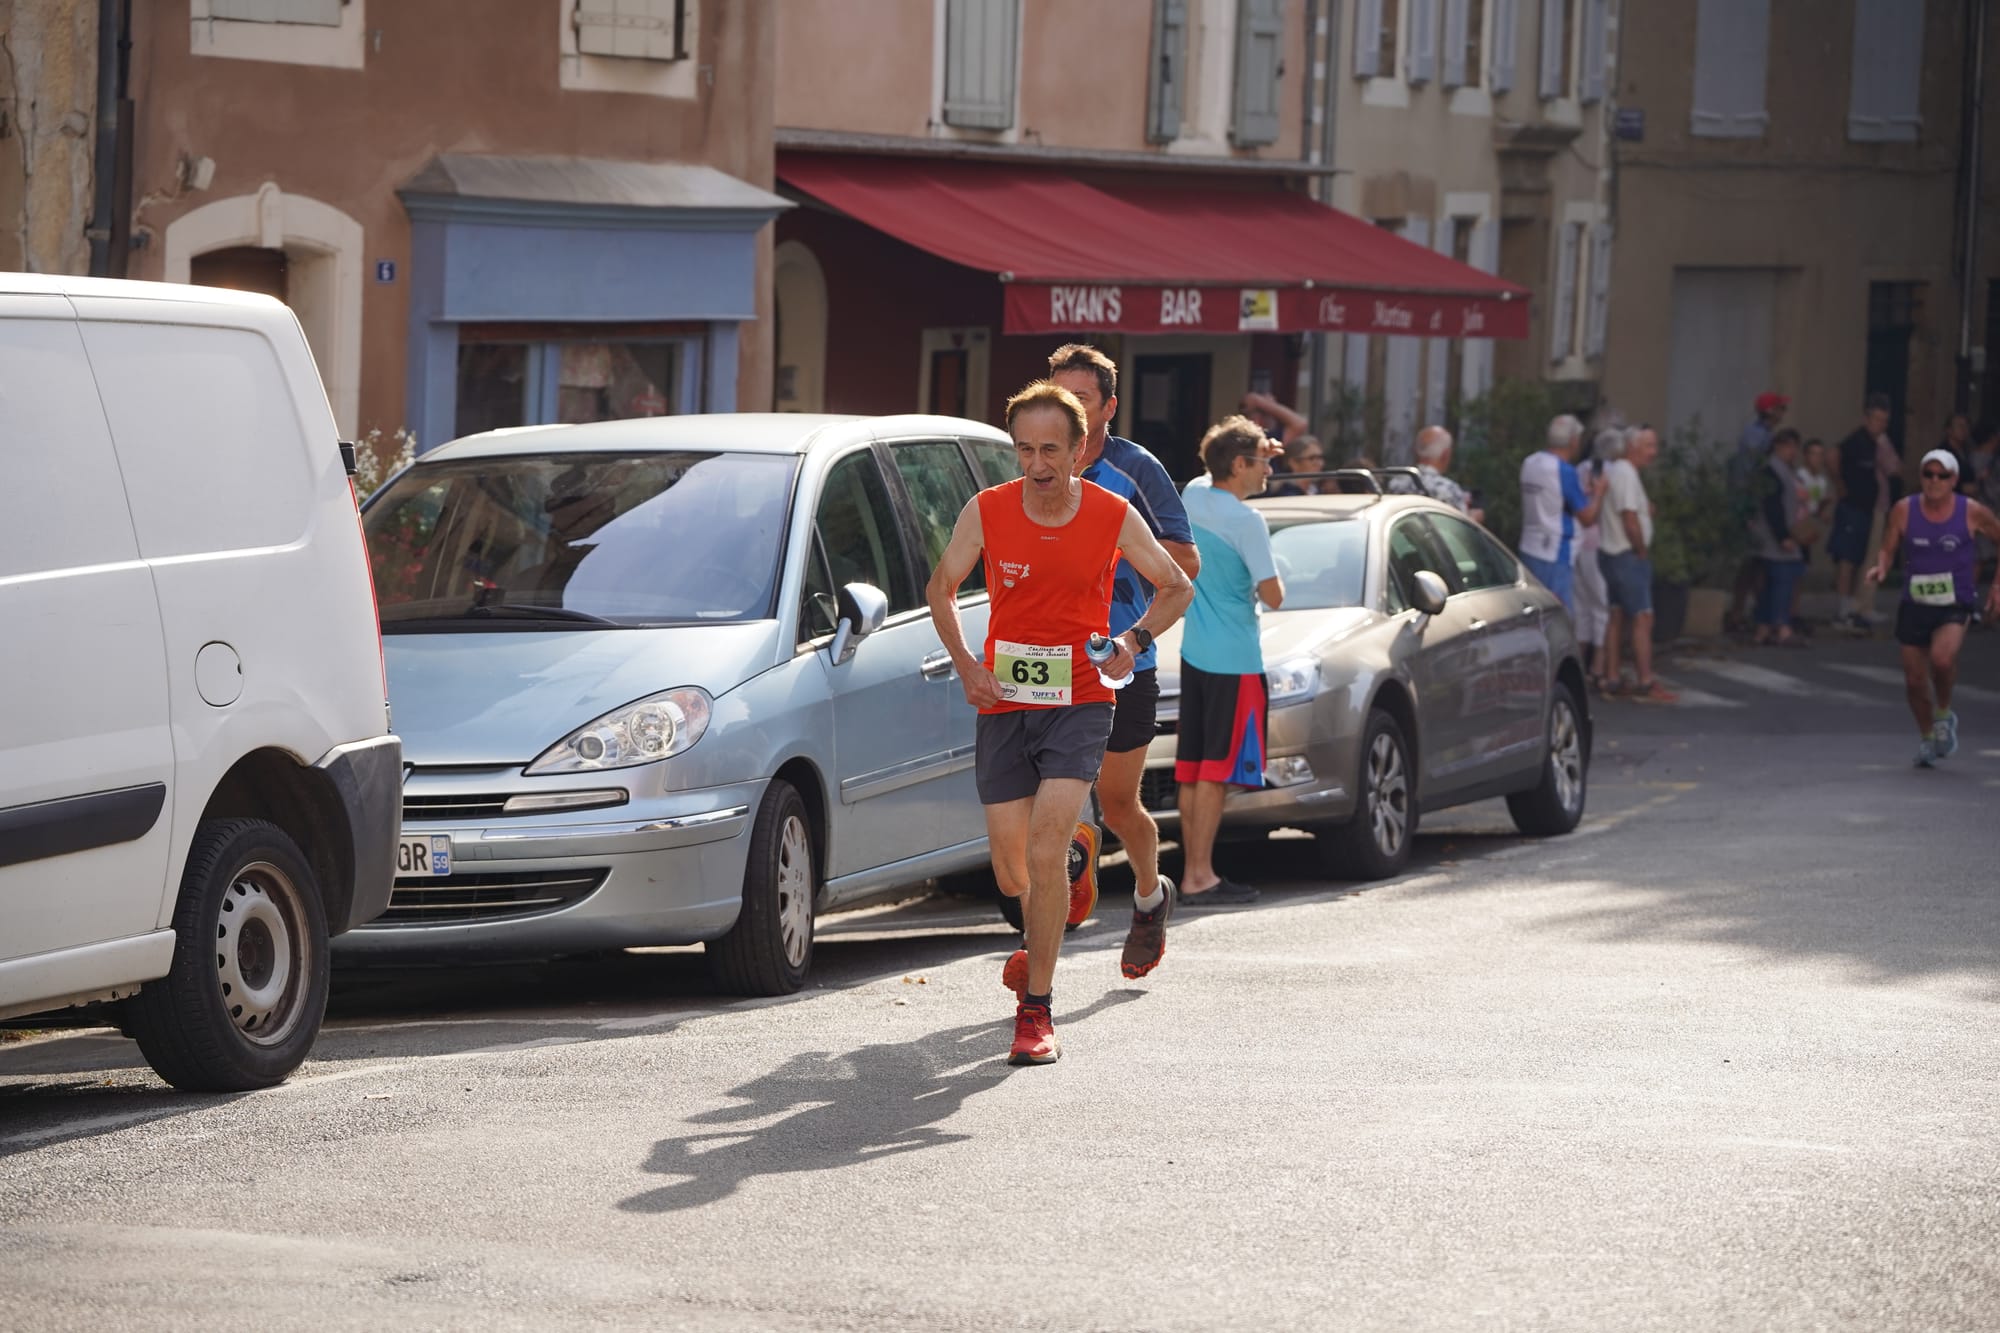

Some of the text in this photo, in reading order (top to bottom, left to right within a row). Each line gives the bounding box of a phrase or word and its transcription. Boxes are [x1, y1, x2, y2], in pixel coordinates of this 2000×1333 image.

[1051, 286, 1122, 324] RYAN'S
[1160, 289, 1203, 325] BAR
[1917, 583, 1947, 596] 123
[1012, 660, 1049, 685] 63
[433, 855, 449, 869] 59
